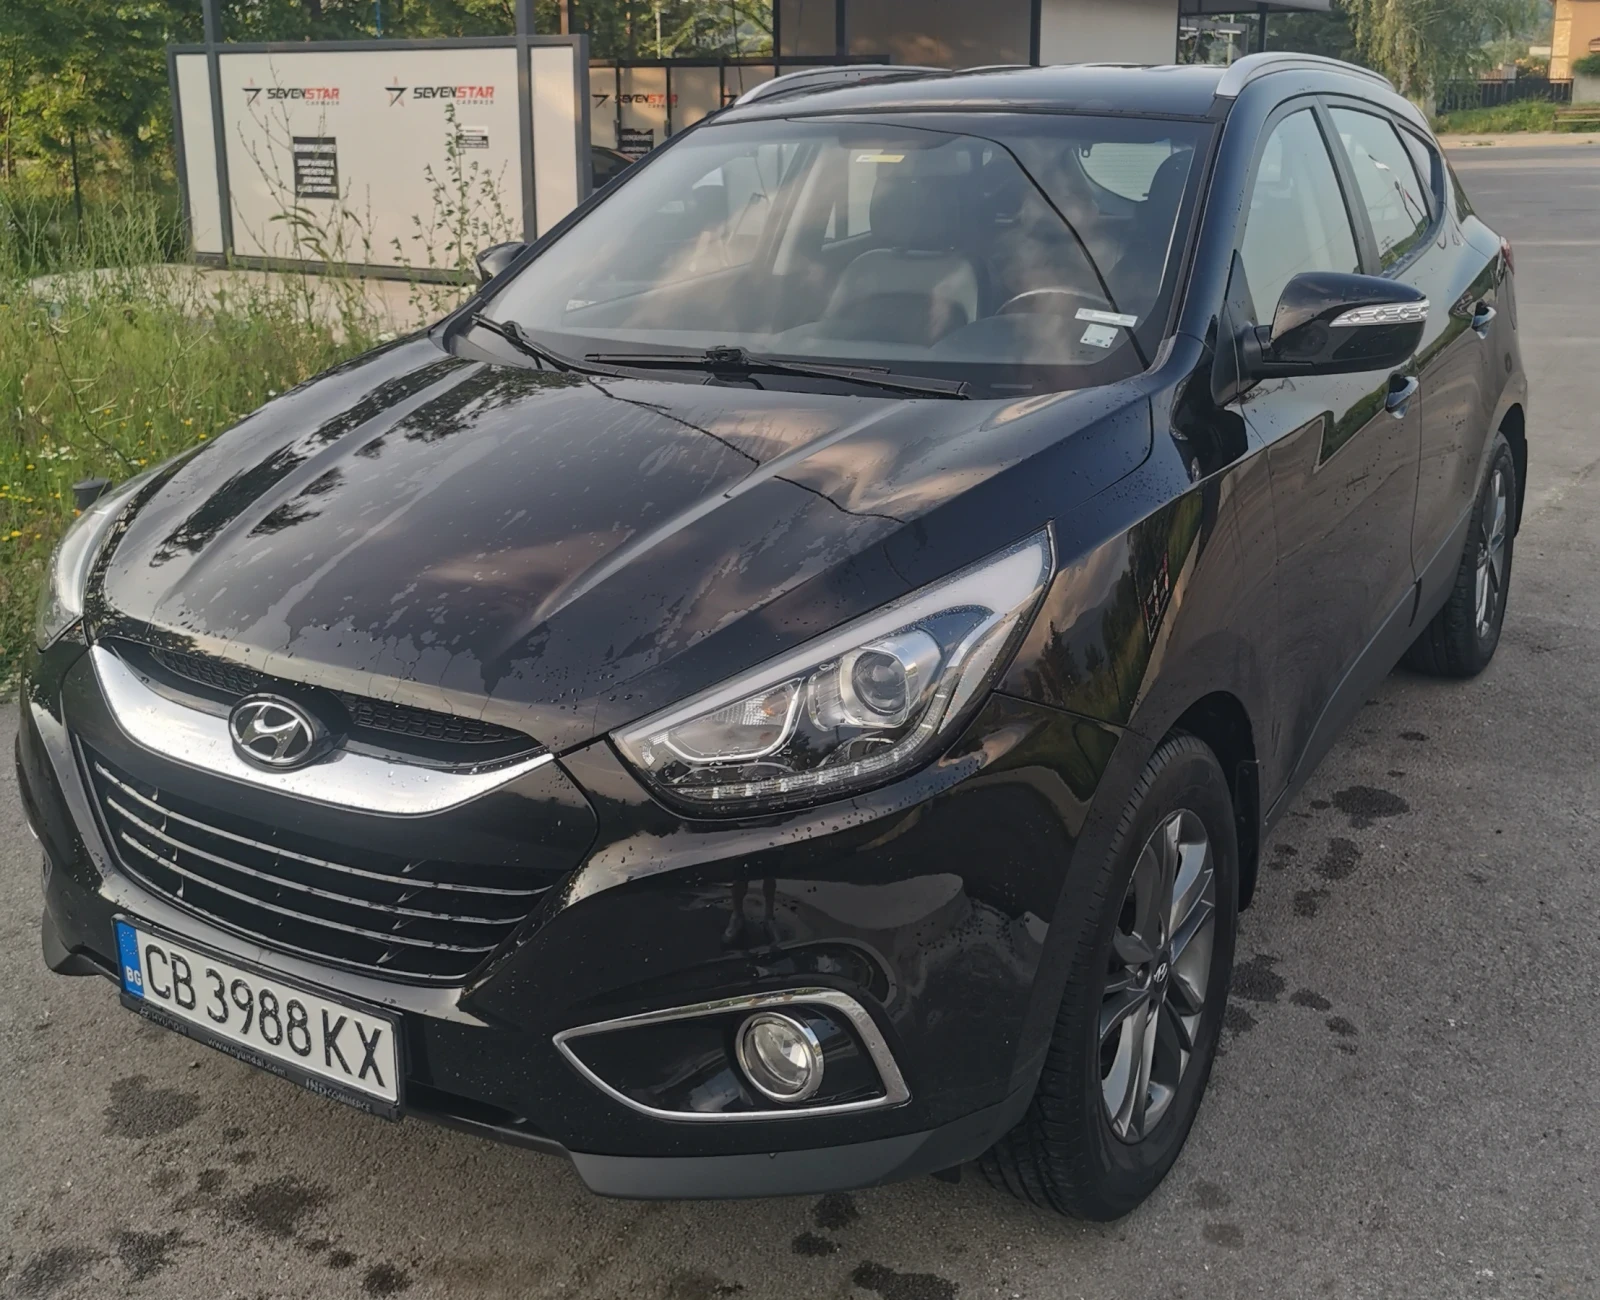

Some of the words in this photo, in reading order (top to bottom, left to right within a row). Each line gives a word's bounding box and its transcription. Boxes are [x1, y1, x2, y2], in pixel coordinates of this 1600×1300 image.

[266, 87, 340, 100] SEVENSTAR
[413, 86, 494, 99] SEVENSTAR
[125, 965, 142, 986] BG
[206, 967, 312, 1058] 3988
